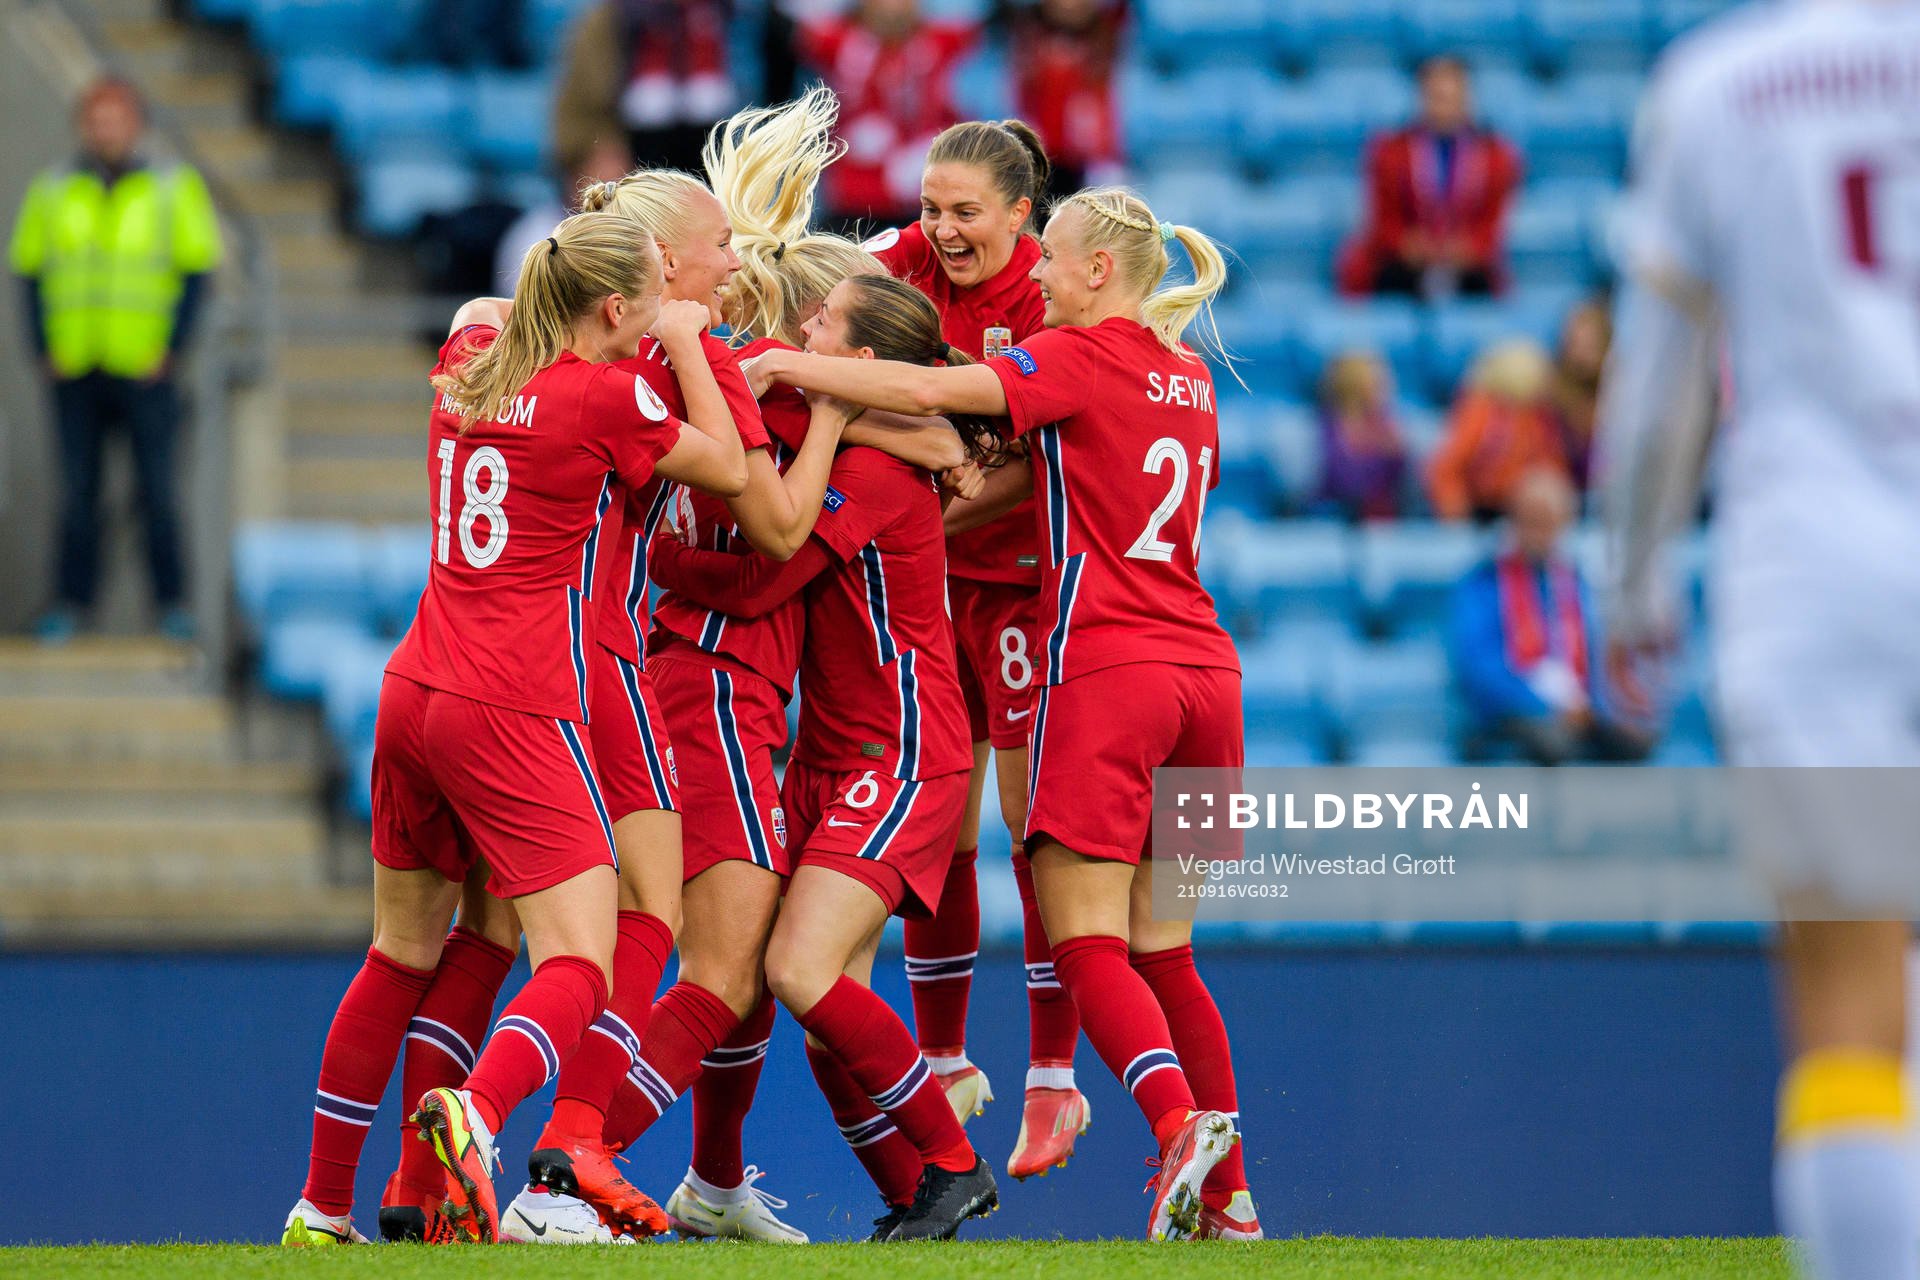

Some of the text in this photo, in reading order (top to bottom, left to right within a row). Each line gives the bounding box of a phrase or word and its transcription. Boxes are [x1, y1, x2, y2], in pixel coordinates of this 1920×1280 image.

[1146, 371, 1214, 414] SÆVIK
[437, 438, 510, 569] 18
[1123, 437, 1213, 571] 21
[1000, 626, 1032, 690] 8
[845, 770, 879, 808] 6
